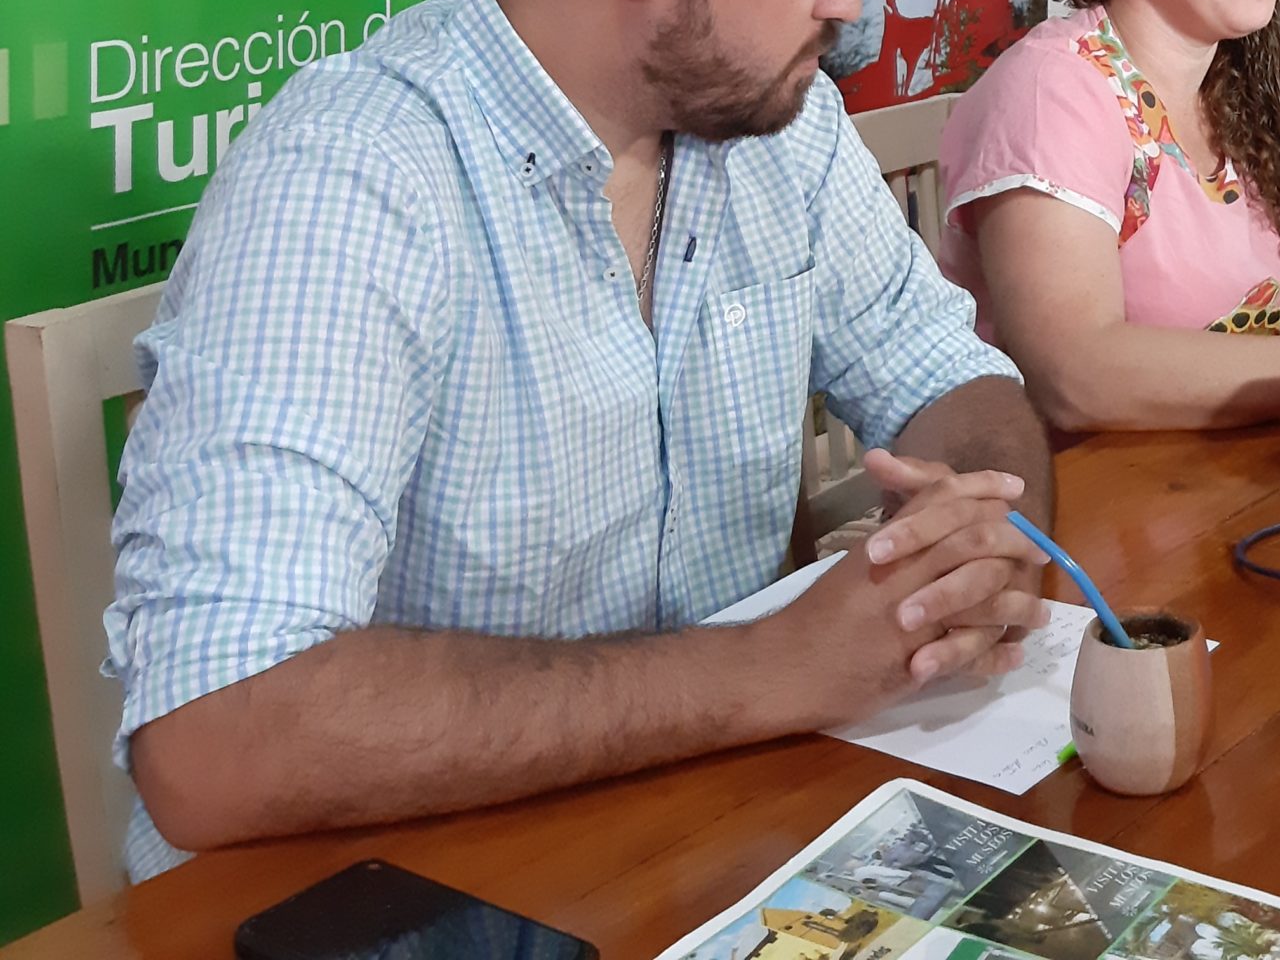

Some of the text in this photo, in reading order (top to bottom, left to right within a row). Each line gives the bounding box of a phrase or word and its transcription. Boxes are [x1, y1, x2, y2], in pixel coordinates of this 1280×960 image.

[90, 10, 347, 104] Dirección
[965, 829, 1014, 867] MUSEOS
[976, 823, 1001, 846] LOS
[1109, 870, 1153, 909] MUSEOS
[1115, 865, 1140, 887] LOS
